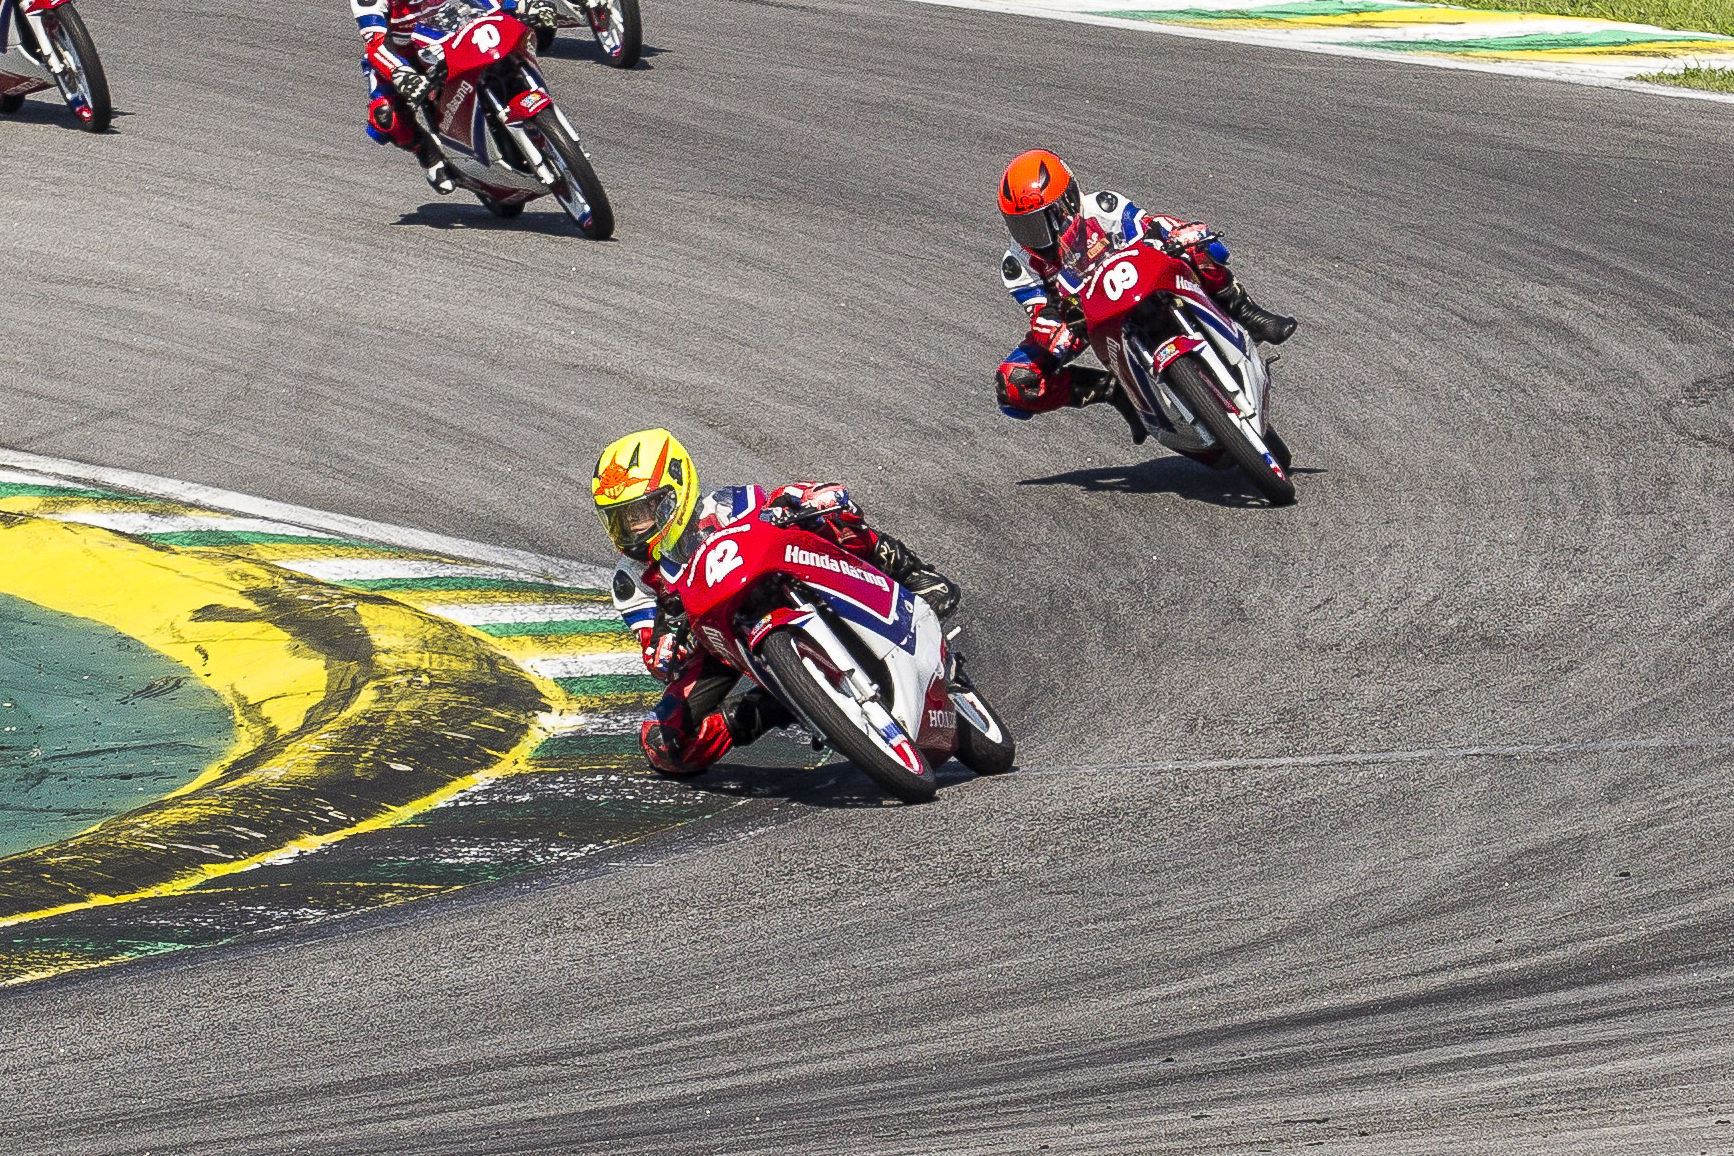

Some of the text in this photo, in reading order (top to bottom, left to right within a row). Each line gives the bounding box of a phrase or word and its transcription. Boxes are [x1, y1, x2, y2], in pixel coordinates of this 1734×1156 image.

[1103, 262, 1138, 301] 09
[785, 544, 891, 593] Honda Racing
